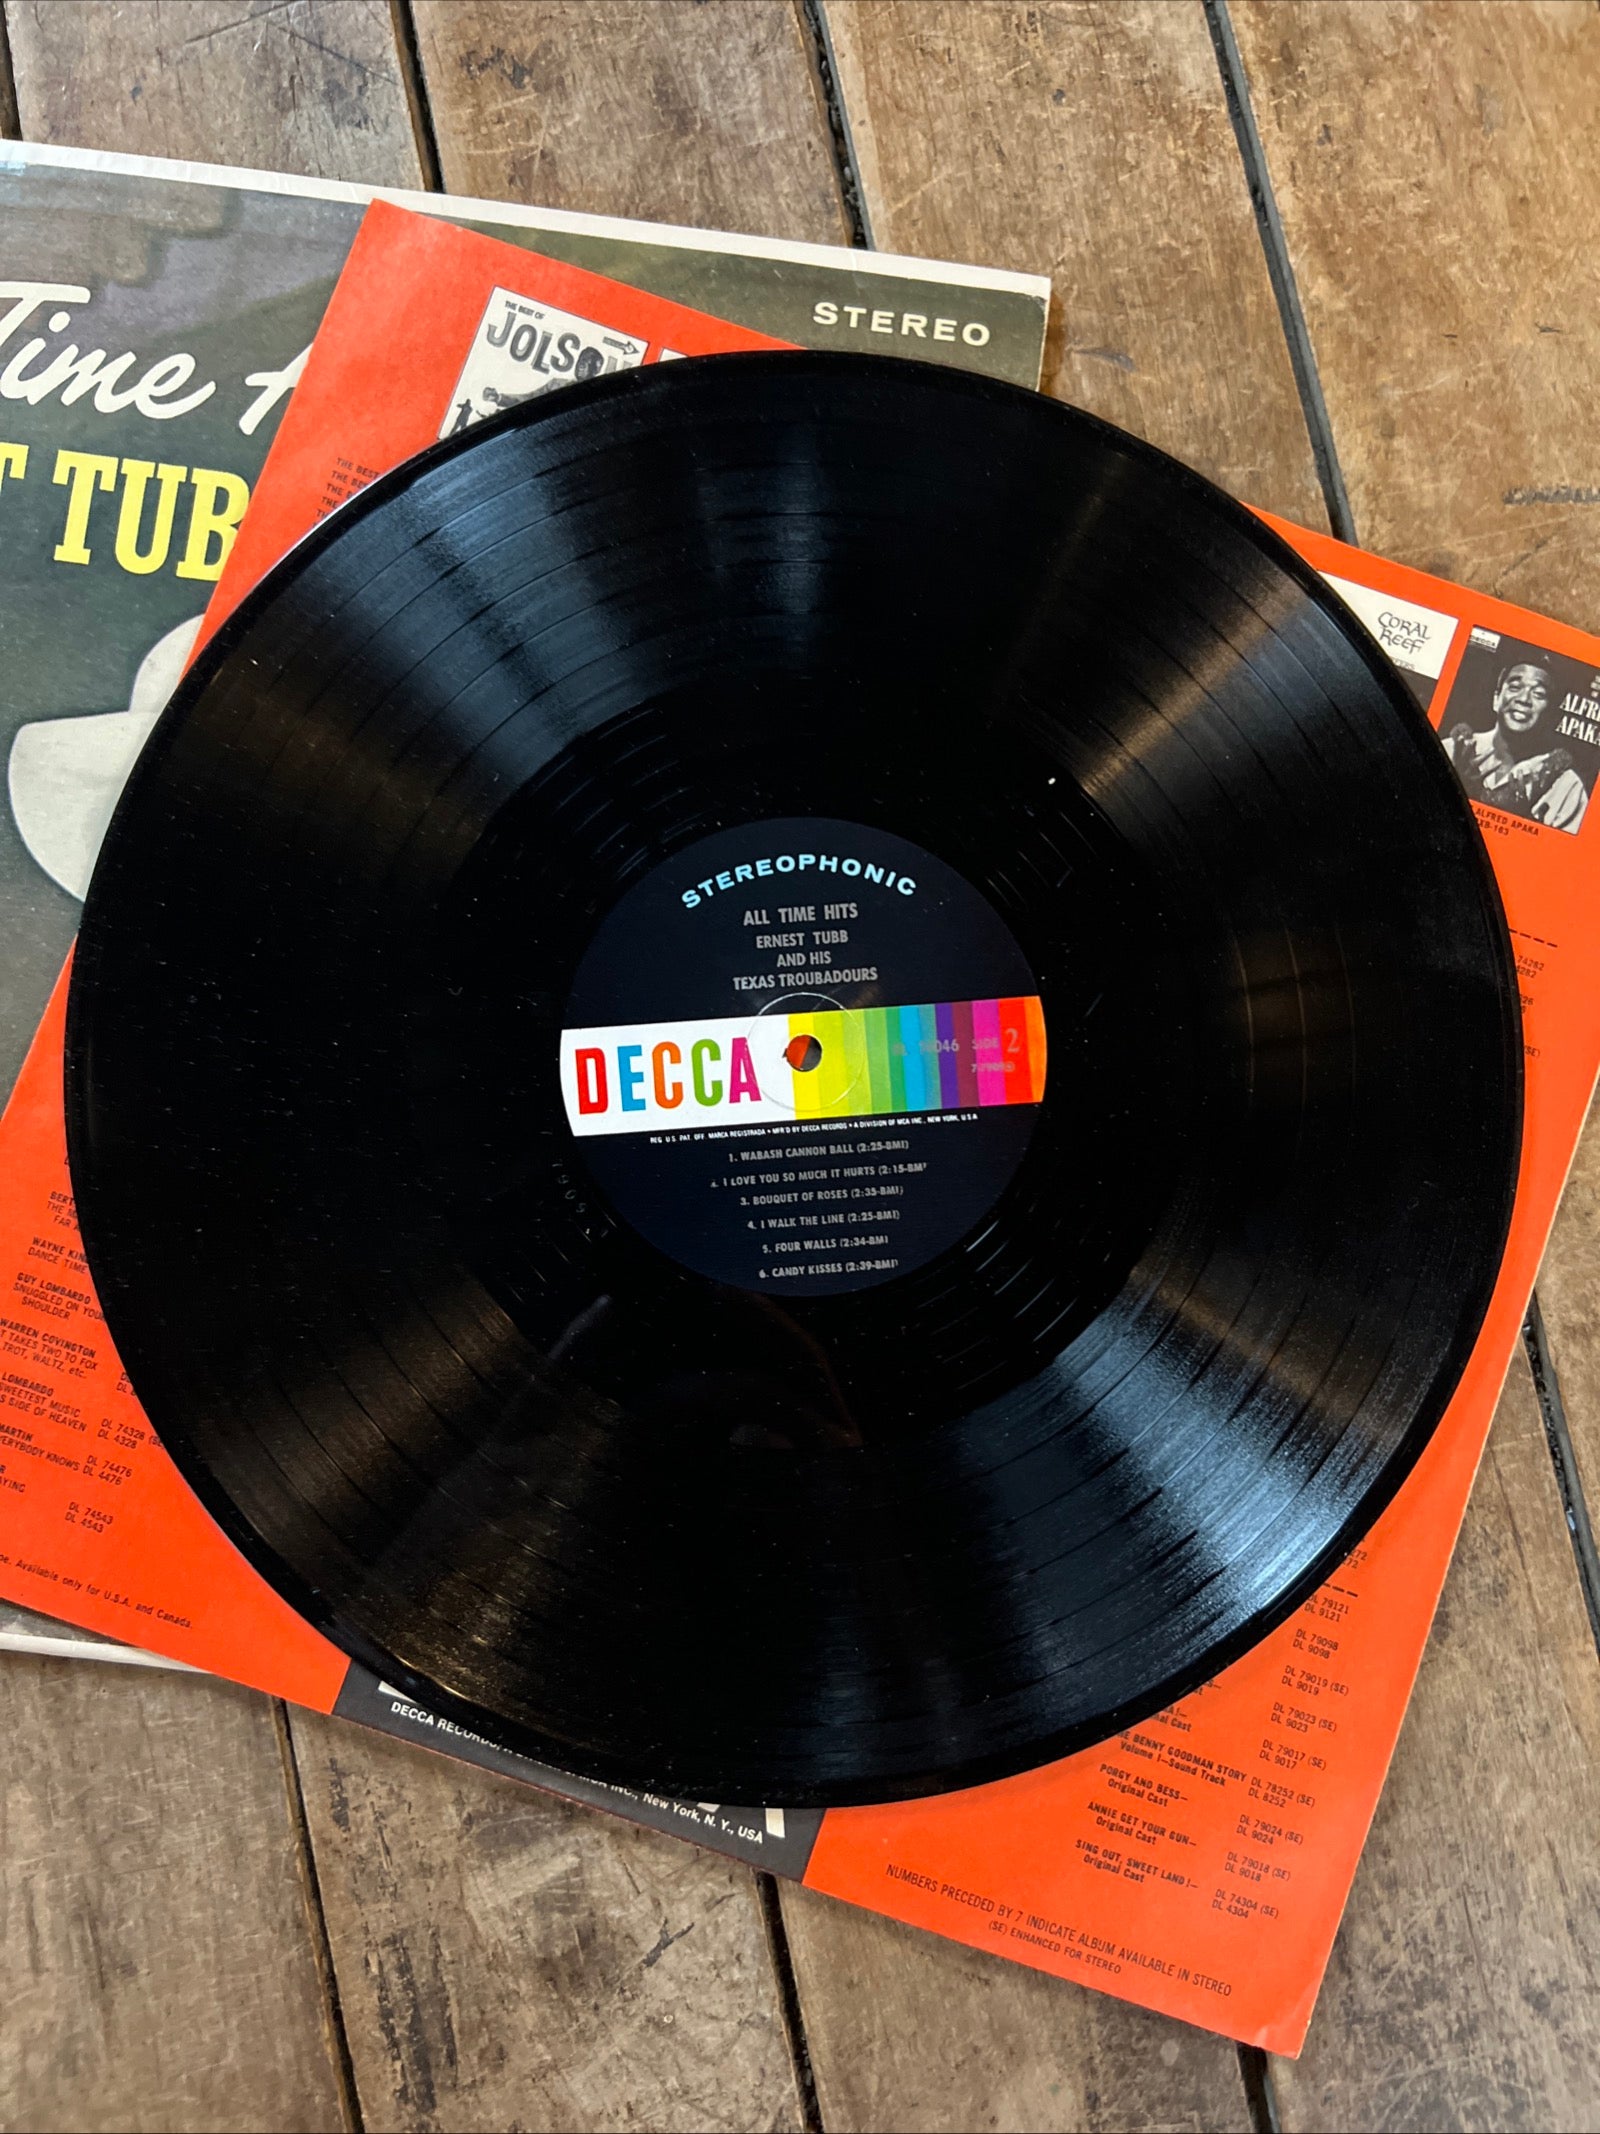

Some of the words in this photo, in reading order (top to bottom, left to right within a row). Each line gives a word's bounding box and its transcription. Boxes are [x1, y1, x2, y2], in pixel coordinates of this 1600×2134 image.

[812, 301, 991, 347] STEREO
[0, 281, 217, 419] Time
[336, 457, 353, 469] THE
[330, 470, 348, 483] THE
[326, 483, 343, 495] THE
[1377, 611, 1431, 640] CORAL
[1379, 629, 1425, 654] REEF
[1475, 807, 1508, 825] ALFRED
[1510, 820, 1539, 835] APAKA
[681, 854, 917, 908] STEREOPHONIC
[743, 910, 770, 926] ALL
[778, 906, 816, 923] TIME
[824, 903, 859, 920] HITS
[756, 932, 805, 949] ERNEST
[813, 930, 849, 945] TUBB
[777, 953, 806, 967] AND
[810, 951, 832, 965] HIS
[733, 974, 775, 990] TEXAS
[778, 967, 878, 987] TROUBADOURS
[1005, 1028, 1020, 1053] 2
[575, 1037, 762, 1115] DECCA
[729, 1128, 765, 1137] REGISTRADA
[801, 1124, 820, 1132] DECCA
[821, 1122, 847, 1131] RECORDS
[859, 1119, 886, 1128] DIVISION
[740, 1149, 782, 1161] WABASH
[785, 1145, 826, 1157] CANNON
[829, 1143, 853, 1154] BALL
[856, 1139, 909, 1152] (2:25-BMI)
[730, 1175, 756, 1186] LOVE
[759, 1173, 779, 1183] YOU
[782, 1172, 795, 1182] SO
[798, 1170, 826, 1180] MUCH
[830, 1169, 840, 1178] IT
[843, 1166, 875, 1177] HURTS
[45, 1201, 63, 1214] THE
[740, 1197, 749, 1206] 3.
[753, 1193, 798, 1205] BOUQUET
[801, 1191, 814, 1201] OF
[817, 1189, 847, 1200] ROSES
[53, 1215, 70, 1227] FAR
[747, 1220, 756, 1230] 4.
[767, 1217, 795, 1228] WALK
[800, 1215, 817, 1225] THE
[821, 1213, 844, 1224] LINE
[31, 1236, 65, 1255] WAYNE
[762, 1244, 771, 1253] 5.
[775, 1241, 800, 1252] FOUR
[803, 1238, 836, 1250] WALLS
[27, 1246, 59, 1264] DANCE
[63, 1259, 87, 1274] TIME
[759, 1269, 769, 1278] 6.
[771, 1266, 804, 1277] CANDY
[808, 1263, 842, 1274] KISSES
[12, 1281, 63, 1306] SNUGGLED
[65, 1300, 79, 1312] ON
[16, 1271, 36, 1285] GUY
[39, 1279, 91, 1305] LOMBARDO
[21, 1296, 70, 1320] SHOULDER
[0, 1317, 39, 1338] WARREN
[41, 1332, 96, 1358] COVINGTON
[8, 1332, 38, 1349] TAKES
[40, 1344, 62, 1358] TWO
[64, 1352, 76, 1363] TO
[79, 1357, 97, 1370] FOX
[1, 1371, 54, 1397] LOMBARDO
[33, 1405, 46, 1417] OF
[48, 1411, 87, 1432] HEAVEN
[49, 1399, 80, 1418] MUSIC
[112, 1433, 137, 1449] 4328
[116, 1423, 145, 1441] 74328
[45, 1451, 80, 1471] KNOWS
[101, 1459, 132, 1478] 74476
[97, 1470, 122, 1486] 4476
[79, 1517, 104, 1533] 4543
[84, 1507, 114, 1525] 74543
[15, 1558, 60, 1581] Available
[61, 1575, 83, 1591] only
[85, 1584, 100, 1596] for
[103, 1590, 132, 1607] U.S.A.
[135, 1601, 153, 1615] and
[155, 1608, 194, 1629] Canada.
[1318, 1607, 1341, 1622] 9121
[1321, 1597, 1349, 1614] 79121
[1306, 1644, 1331, 1659] 9098
[1309, 1633, 1339, 1651] 79098
[1296, 1680, 1319, 1695] 9019
[1298, 1670, 1328, 1687] 79019
[1329, 1681, 1350, 1696] (SE)
[391, 1701, 434, 1726] DECCA
[1285, 1718, 1309, 1732] 9023
[1286, 1707, 1317, 1725] 79023
[1317, 1718, 1338, 1732] (SE)
[1119, 1741, 1154, 1759] Volume
[1199, 1768, 1227, 1786] Track
[1132, 1733, 1165, 1752] BENNY
[1166, 1745, 1214, 1770] GOODMAN
[1215, 1763, 1247, 1782] STORY
[1273, 1755, 1296, 1770] 9017
[1276, 1744, 1306, 1761] 79017
[1306, 1755, 1327, 1771] (SE)
[1099, 1763, 1131, 1782] PORGY
[1132, 1775, 1153, 1789] AND
[1106, 1778, 1145, 1799] Original
[1146, 1792, 1168, 1806] Cast
[1262, 1792, 1286, 1807] 8252
[1264, 1782, 1295, 1799] 78252
[1295, 1793, 1316, 1808] (SE)
[643, 1793, 669, 1809] New
[672, 1803, 701, 1823] York,
[737, 1825, 764, 1844] USA
[1086, 1801, 1117, 1818] ANNIE
[1119, 1812, 1138, 1826] GET
[1140, 1820, 1166, 1836] YOUR
[1094, 1816, 1133, 1837] Original
[1134, 1830, 1157, 1844] Cast
[1250, 1830, 1274, 1845] 9024
[1253, 1819, 1283, 1836] 79024
[1284, 1830, 1304, 1845] (SE)
[1074, 1839, 1099, 1854] SING
[1125, 1857, 1158, 1876] SWEET
[1082, 1854, 1121, 1874] Original
[1122, 1867, 1145, 1882] Cast
[1240, 1856, 1270, 1873] 79018
[1271, 1867, 1291, 1882] (SE)
[1238, 1867, 1262, 1881] 9018
[1225, 1904, 1249, 1918] 4304
[1229, 1892, 1258, 1910] 74304
[1259, 1904, 1280, 1919] (SE)
[885, 1863, 939, 1892] NUMBERS
[939, 1883, 995, 1913] PRECEDED
[996, 1904, 1013, 1919] BY
[1014, 1910, 1023, 1923] 7
[1025, 1914, 1076, 1941] INDICATE
[1076, 1932, 1116, 1955] ALBUM
[1117, 1946, 1175, 1976] AVAILABLE
[1176, 1967, 1190, 1982] IN
[1191, 1972, 1232, 1997] STEREO
[987, 1919, 1008, 1935] (SE)
[1009, 1927, 1061, 1953] ENHANCED
[1063, 1946, 1083, 1961] FOR
[1084, 1953, 1122, 1975] STEREO
